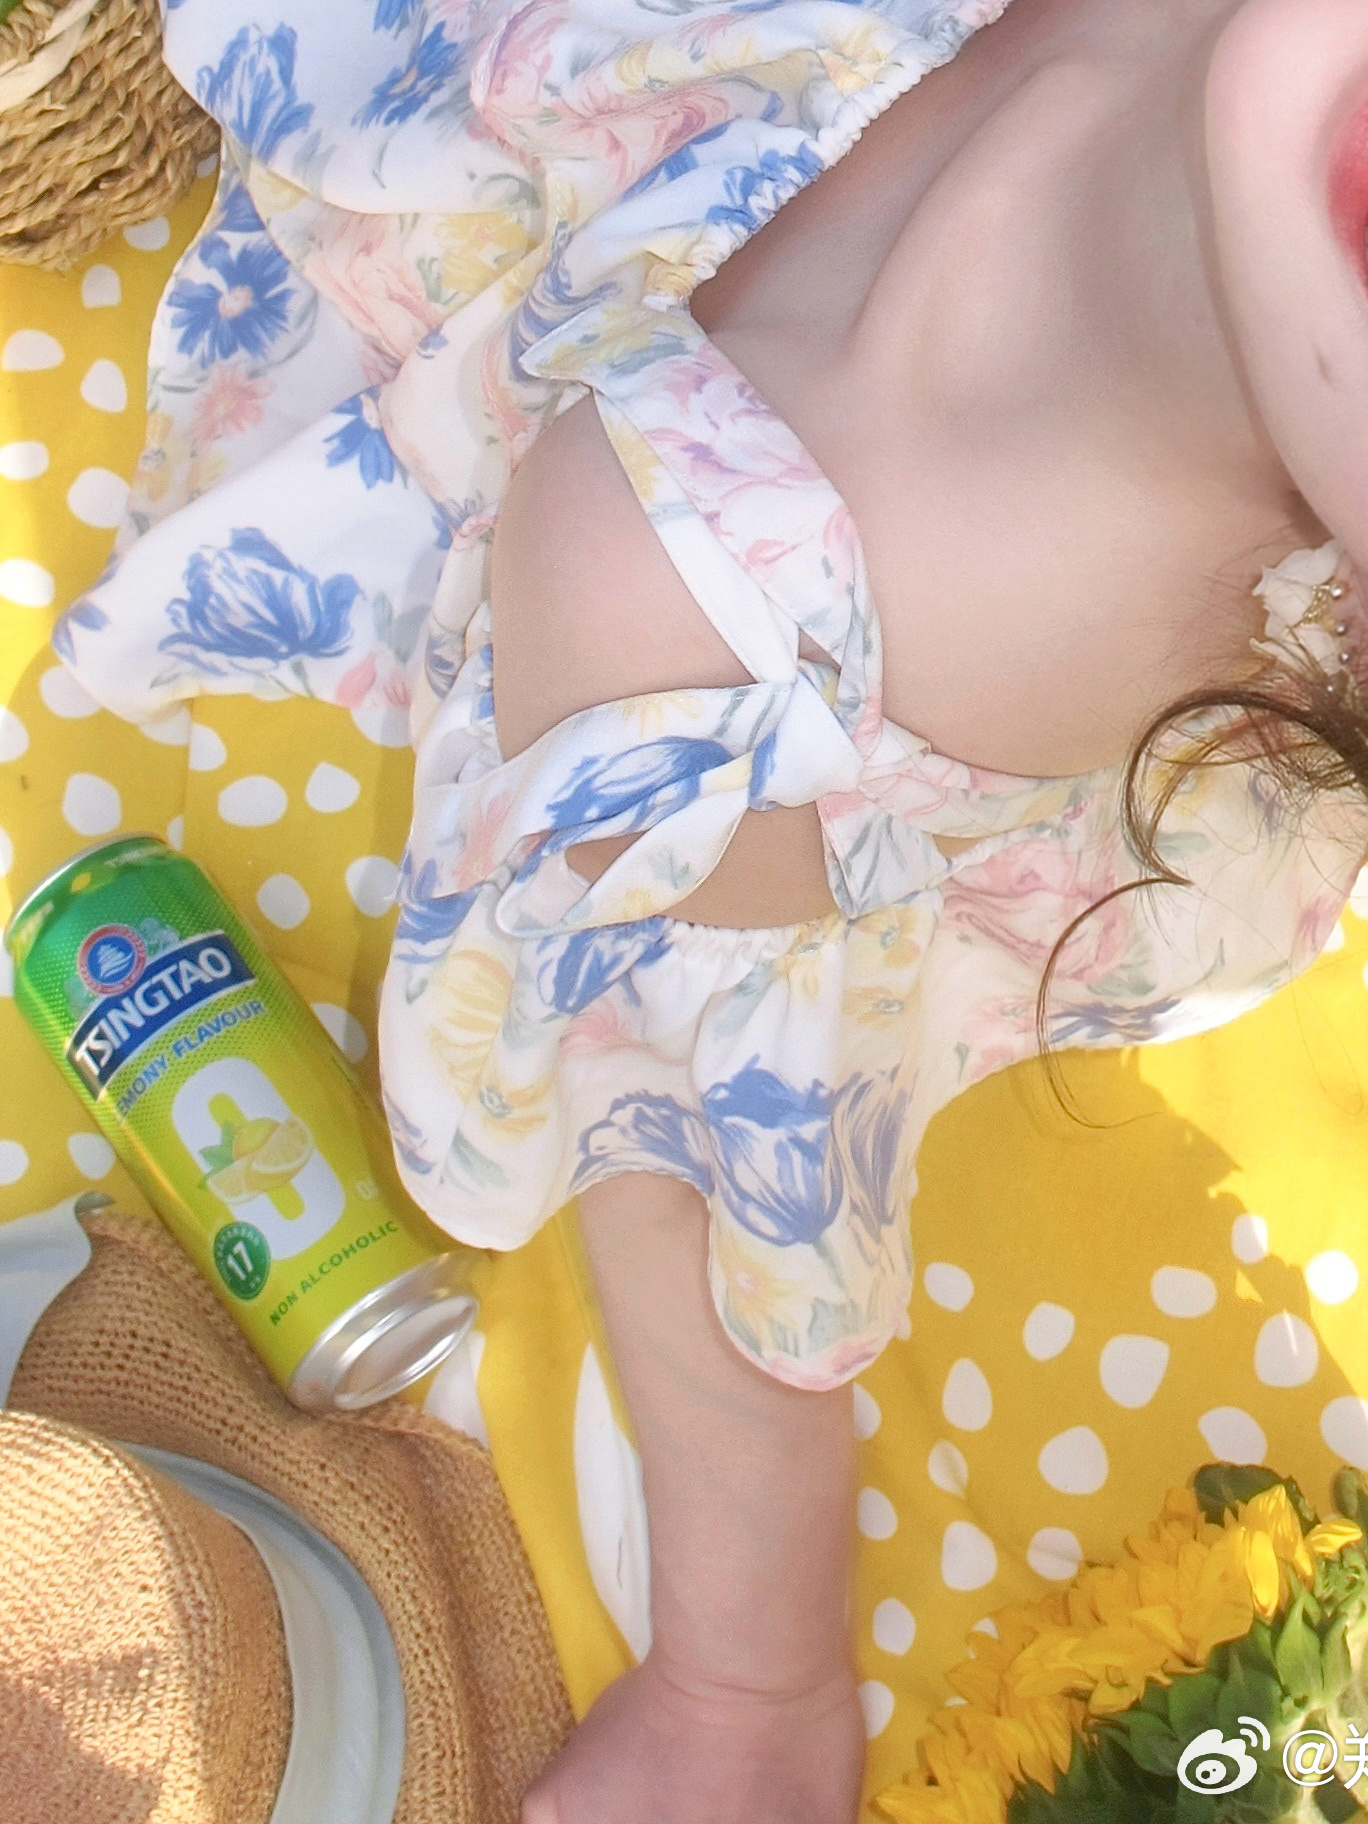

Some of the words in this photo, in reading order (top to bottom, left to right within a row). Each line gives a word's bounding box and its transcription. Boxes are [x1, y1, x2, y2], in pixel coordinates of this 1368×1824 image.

[75, 947, 232, 1076] TSINGTAO
[116, 1055, 169, 1117] EMONY
[171, 999, 266, 1058] FLAVOUR
[226, 1240, 254, 1281] 17
[269, 1290, 299, 1326] NON
[299, 1220, 399, 1295] ALCOHOLIC
